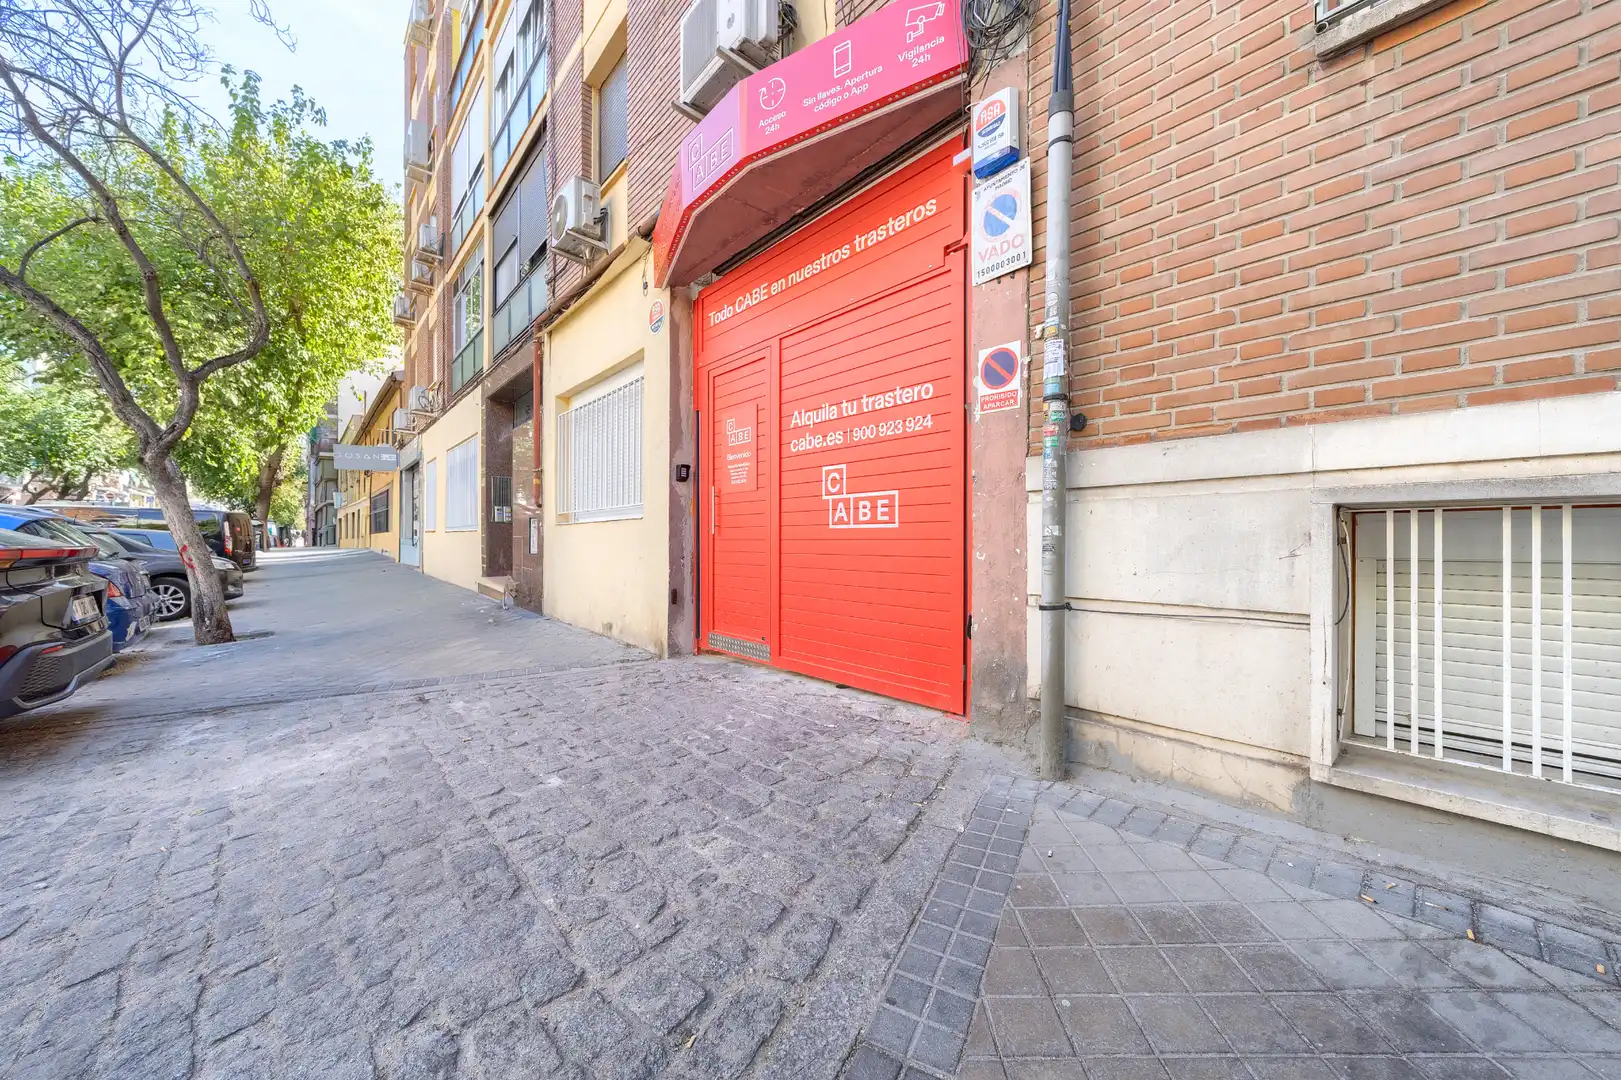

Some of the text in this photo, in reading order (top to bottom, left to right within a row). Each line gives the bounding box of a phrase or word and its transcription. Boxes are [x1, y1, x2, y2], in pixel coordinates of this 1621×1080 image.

[897, 36, 945, 62] Vigilancia
[912, 53, 931, 68] 24h
[803, 96, 816, 107] Sin
[844, 65, 883, 88] Apertura
[814, 82, 869, 113] código o App
[758, 110, 787, 128] Acceso
[765, 123, 780, 135] 24h
[983, 169, 1019, 192] AYUNTAMIENTO
[994, 177, 1013, 191] MADRID
[977, 233, 1025, 263] VADO
[708, 198, 938, 327] Todo CABE en nuestros trasteros
[976, 250, 1027, 278] 1500003001
[790, 383, 934, 429] Alquila tu trastero
[980, 391, 1017, 403] PROHIBIDO
[983, 399, 1015, 410] APARCAR
[790, 414, 933, 452] cabe.es 900 923 924
